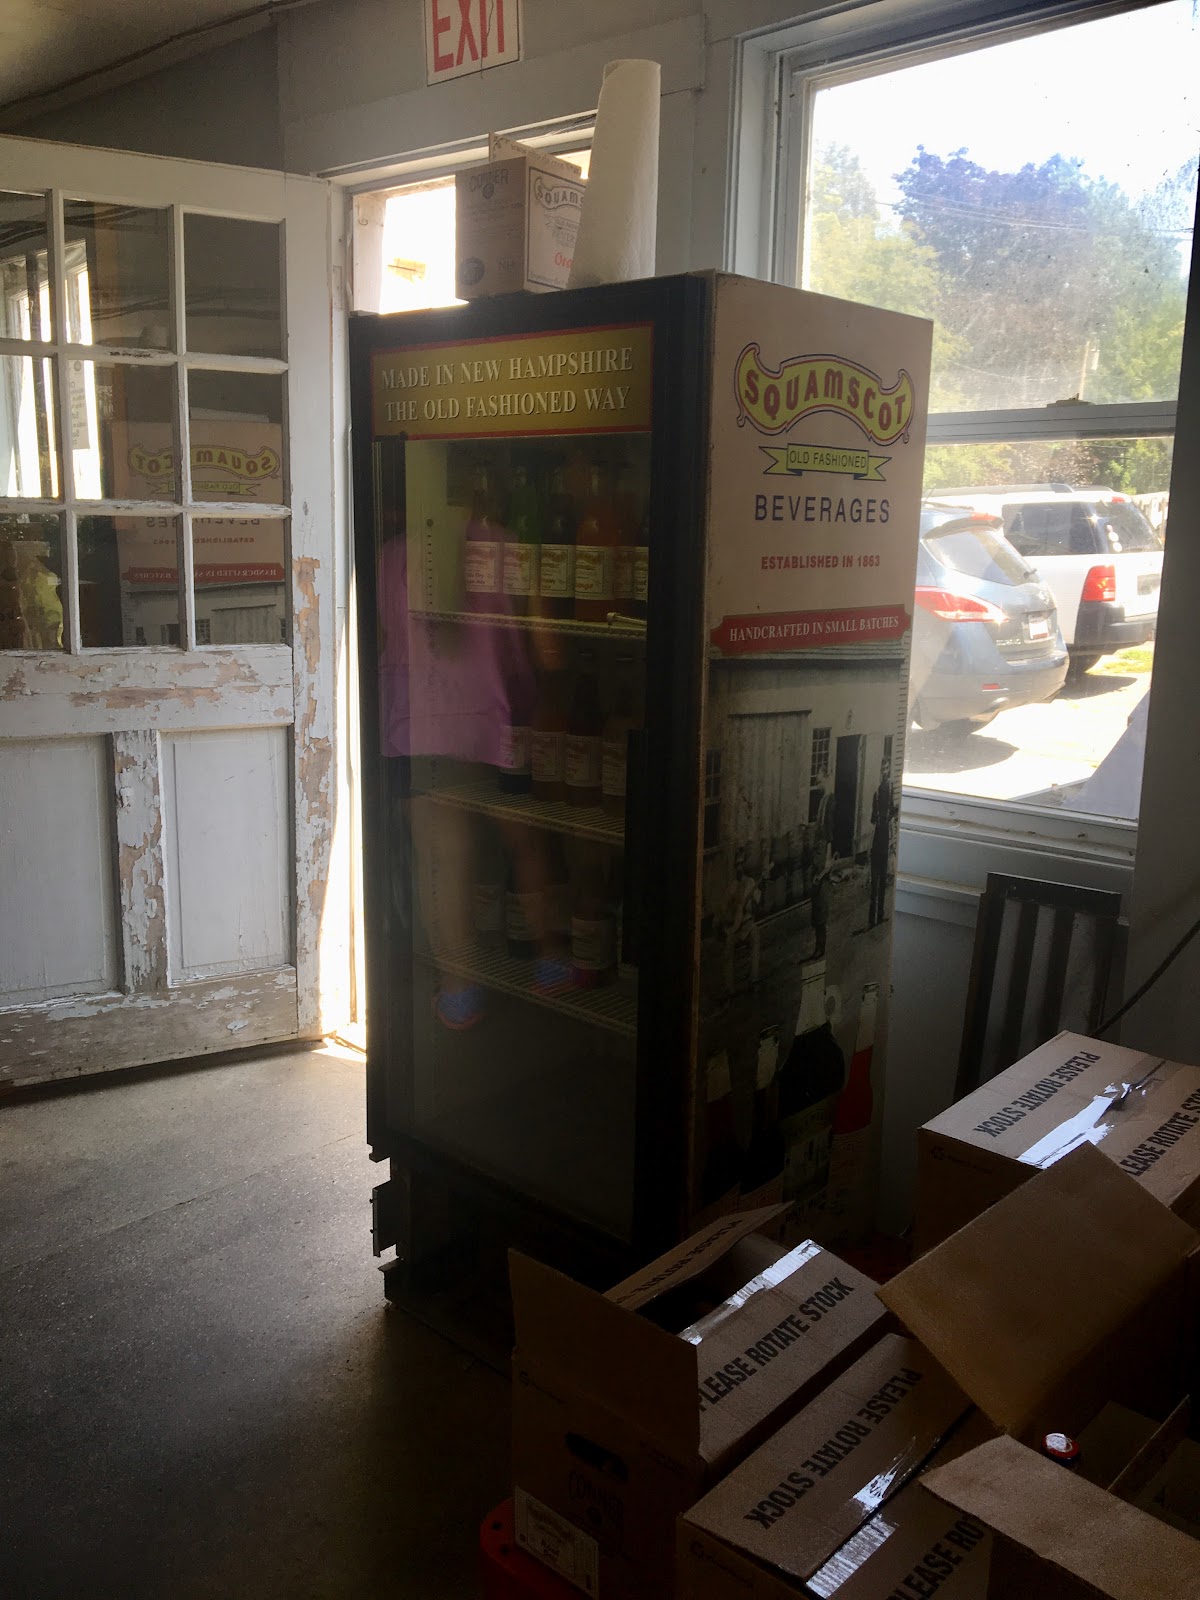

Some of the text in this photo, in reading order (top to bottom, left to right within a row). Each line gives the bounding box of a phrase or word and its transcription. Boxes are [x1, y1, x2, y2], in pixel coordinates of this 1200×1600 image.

[432, 0, 504, 73] EXIT
[381, 347, 633, 390] MADE IN NEW HAMPSHIRE
[385, 386, 631, 422] THE OLD FASHIONED WAY
[744, 367, 907, 431] SQUAMSCOT
[789, 450, 867, 469] OLD FASHIONED
[755, 494, 890, 523] BEVERAGES
[761, 555, 880, 570] ESTABLISHED IN 1863
[729, 615, 899, 642] HANDCRAFTED IN SMALL BATCHES
[972, 1051, 1102, 1138] PLEASE ROTATE STOCK
[1120, 1111, 1200, 1177] LEASE ROTATE
[744, 1314, 811, 1367] ROTATE
[799, 1277, 854, 1322] STOCK
[743, 1368, 923, 1530] PLEASE ROTATE STOCK
